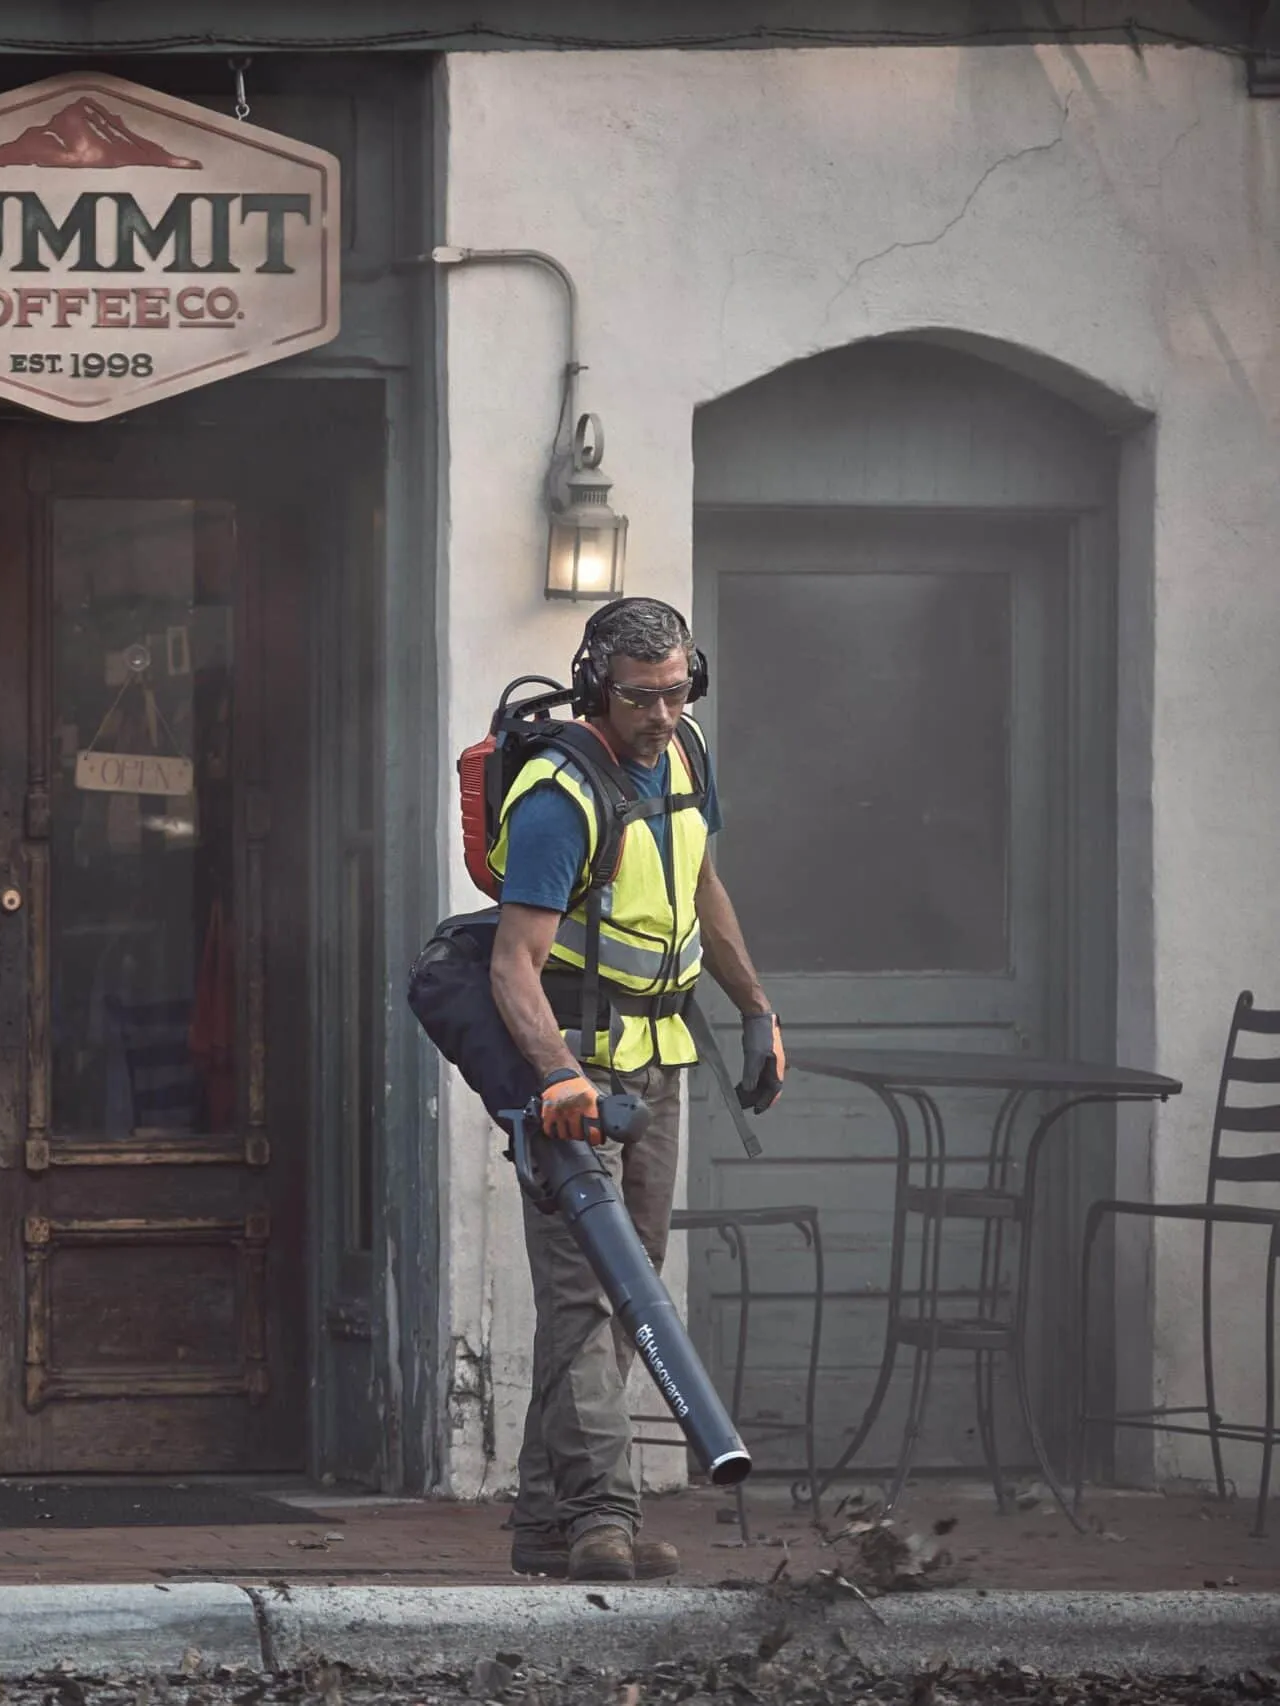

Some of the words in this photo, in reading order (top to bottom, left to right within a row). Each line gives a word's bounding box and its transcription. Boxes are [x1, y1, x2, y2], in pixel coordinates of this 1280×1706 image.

[176, 286, 245, 329] CO.
[10, 353, 64, 374] EST.
[70, 352, 154, 379] 1998
[100, 758, 170, 790] OPEN
[644, 1339, 690, 1417] Husqvarna
